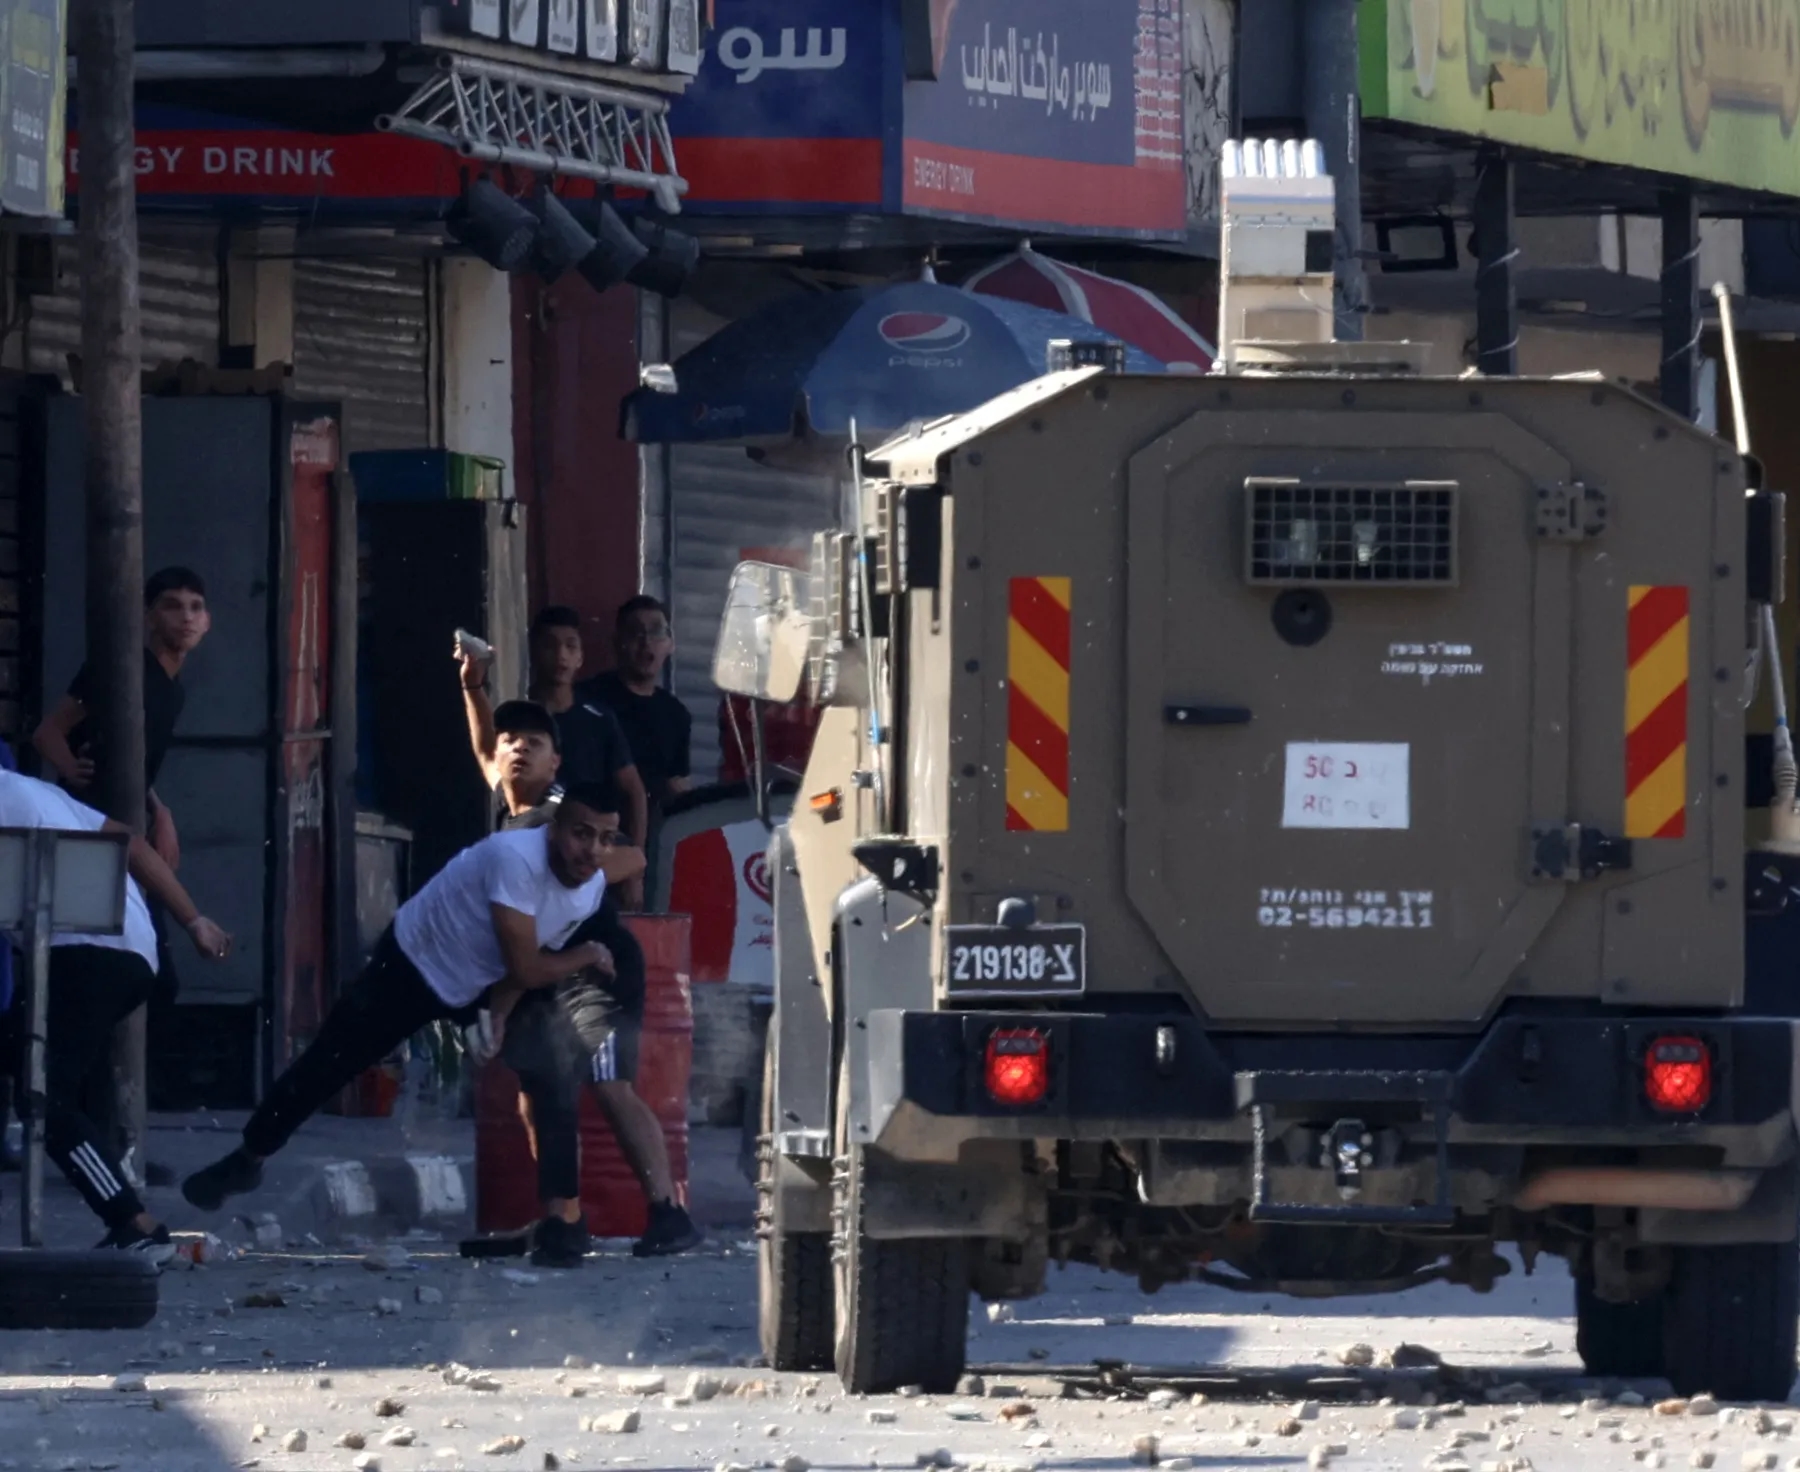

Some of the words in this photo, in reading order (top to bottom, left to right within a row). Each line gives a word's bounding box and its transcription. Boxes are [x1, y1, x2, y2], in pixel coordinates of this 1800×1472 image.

[699, 26, 846, 84] سو
[1017, 31, 1070, 116] ماركت
[1073, 62, 1111, 122] سوبر
[69, 147, 184, 173] EGY
[203, 147, 334, 176] DRINK
[914, 156, 947, 190] ENERGY
[949, 163, 975, 195] DRINK
[888, 354, 963, 367] pepsi
[1258, 906, 1433, 928] 02-5694211
